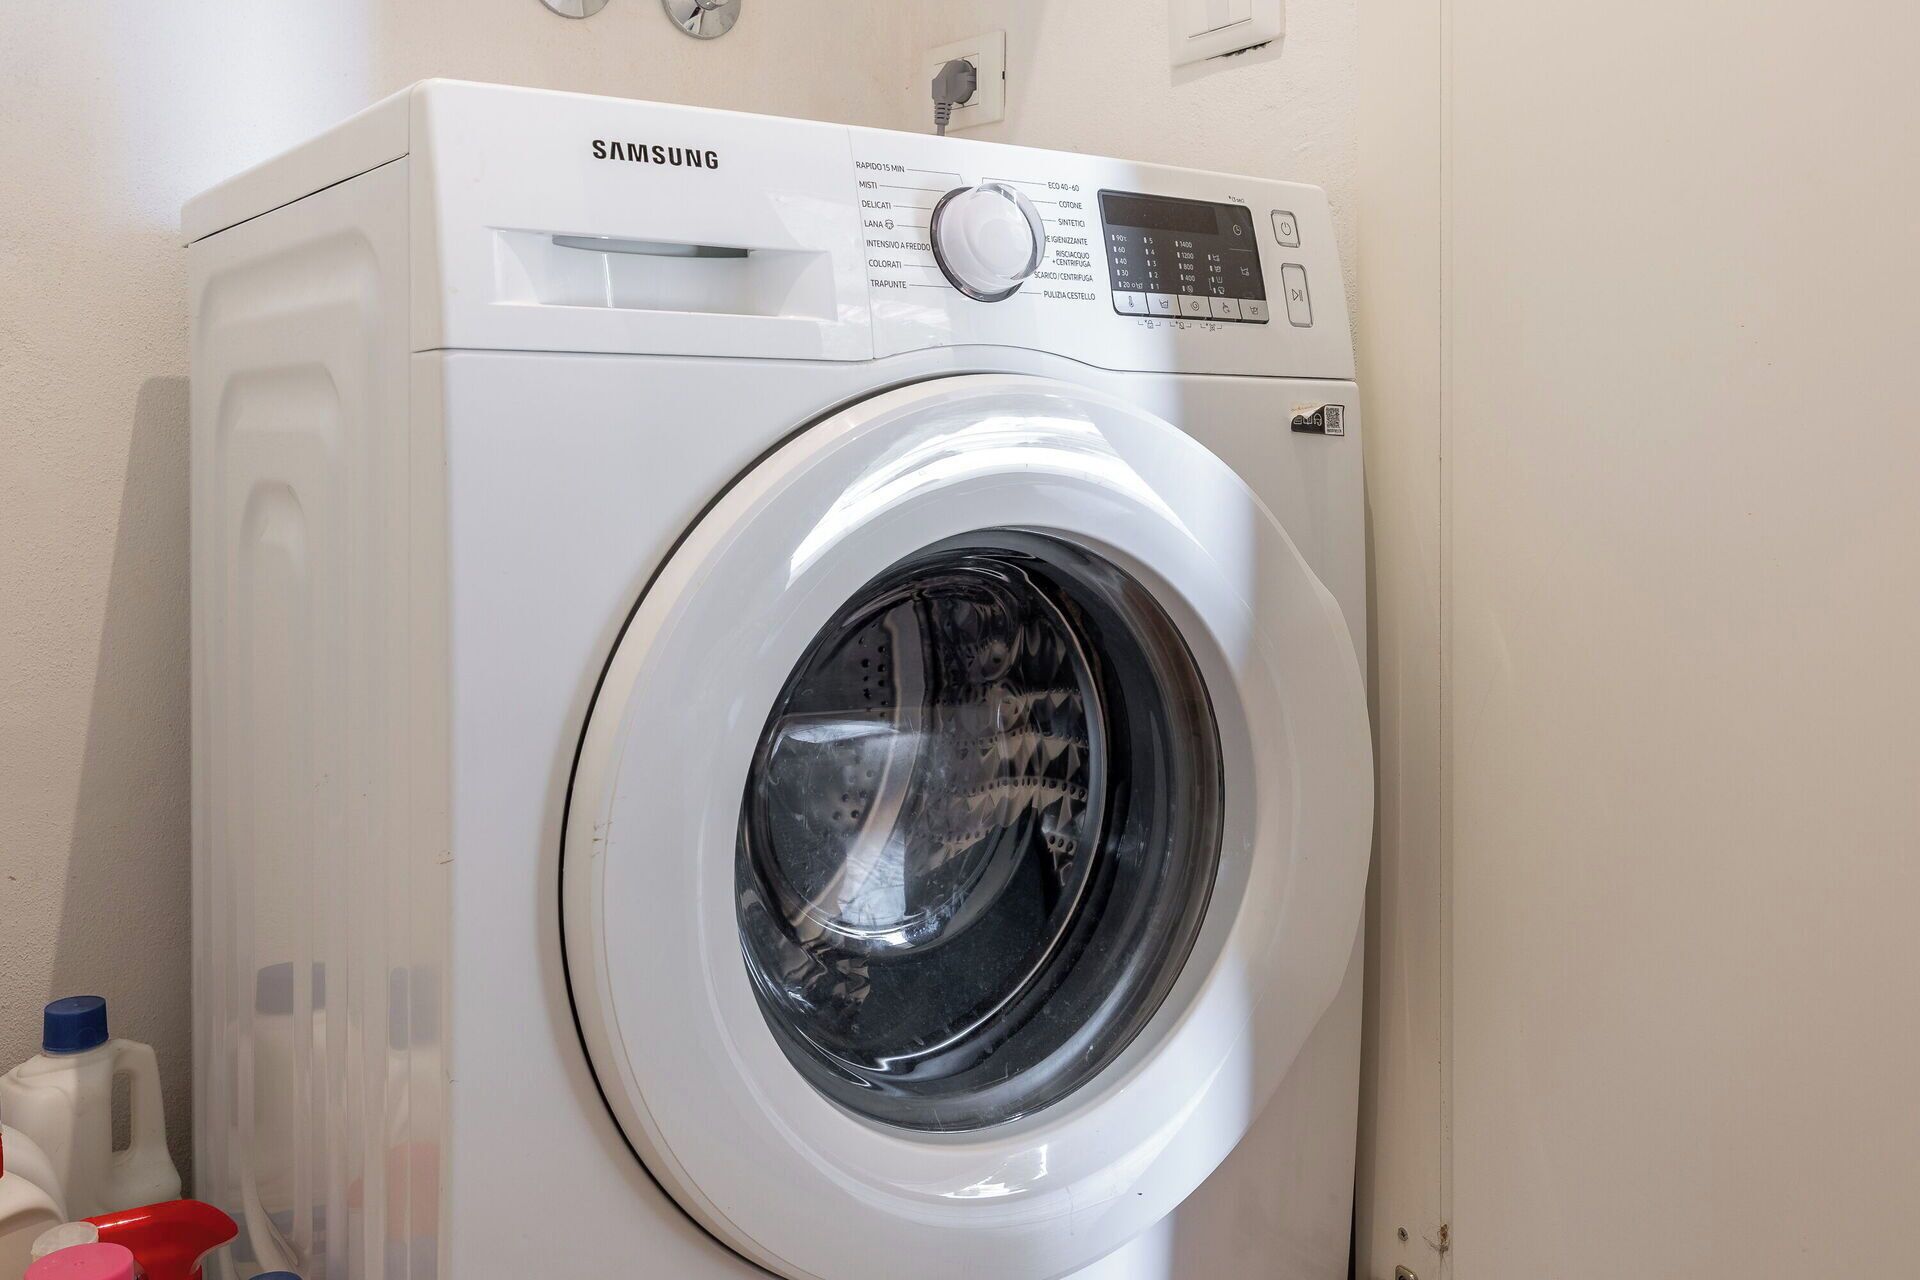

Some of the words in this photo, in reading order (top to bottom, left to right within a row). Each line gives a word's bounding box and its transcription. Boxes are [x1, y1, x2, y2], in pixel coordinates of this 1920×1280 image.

[592, 139, 719, 170] SAMSUNG
[856, 161, 882, 170] RAPIDO
[883, 163, 890, 172] 15
[891, 165, 905, 173] MIN
[859, 180, 878, 189] MISTI
[1048, 182, 1060, 190] ECO
[861, 200, 892, 209] DELICATI
[1058, 200, 1083, 210] COTONE
[864, 219, 884, 228] LANA
[1058, 218, 1085, 228] SINTETICI
[866, 239, 899, 249] INTENSIVO
[900, 241, 905, 250] A
[906, 242, 931, 251] FREDDO
[1051, 236, 1088, 246] IGIENIZZANTE
[1179, 240, 1193, 248] 1400
[1055, 250, 1090, 260] RISCIACQUO
[1181, 252, 1194, 260] 1200
[868, 259, 902, 269] COLORATI
[1183, 263, 1194, 271] 800
[1121, 269, 1129, 277] 30
[870, 279, 907, 289] TRAPUNTE
[1043, 290, 1066, 299] PULIZIA
[1066, 291, 1096, 301] CESTELLO
